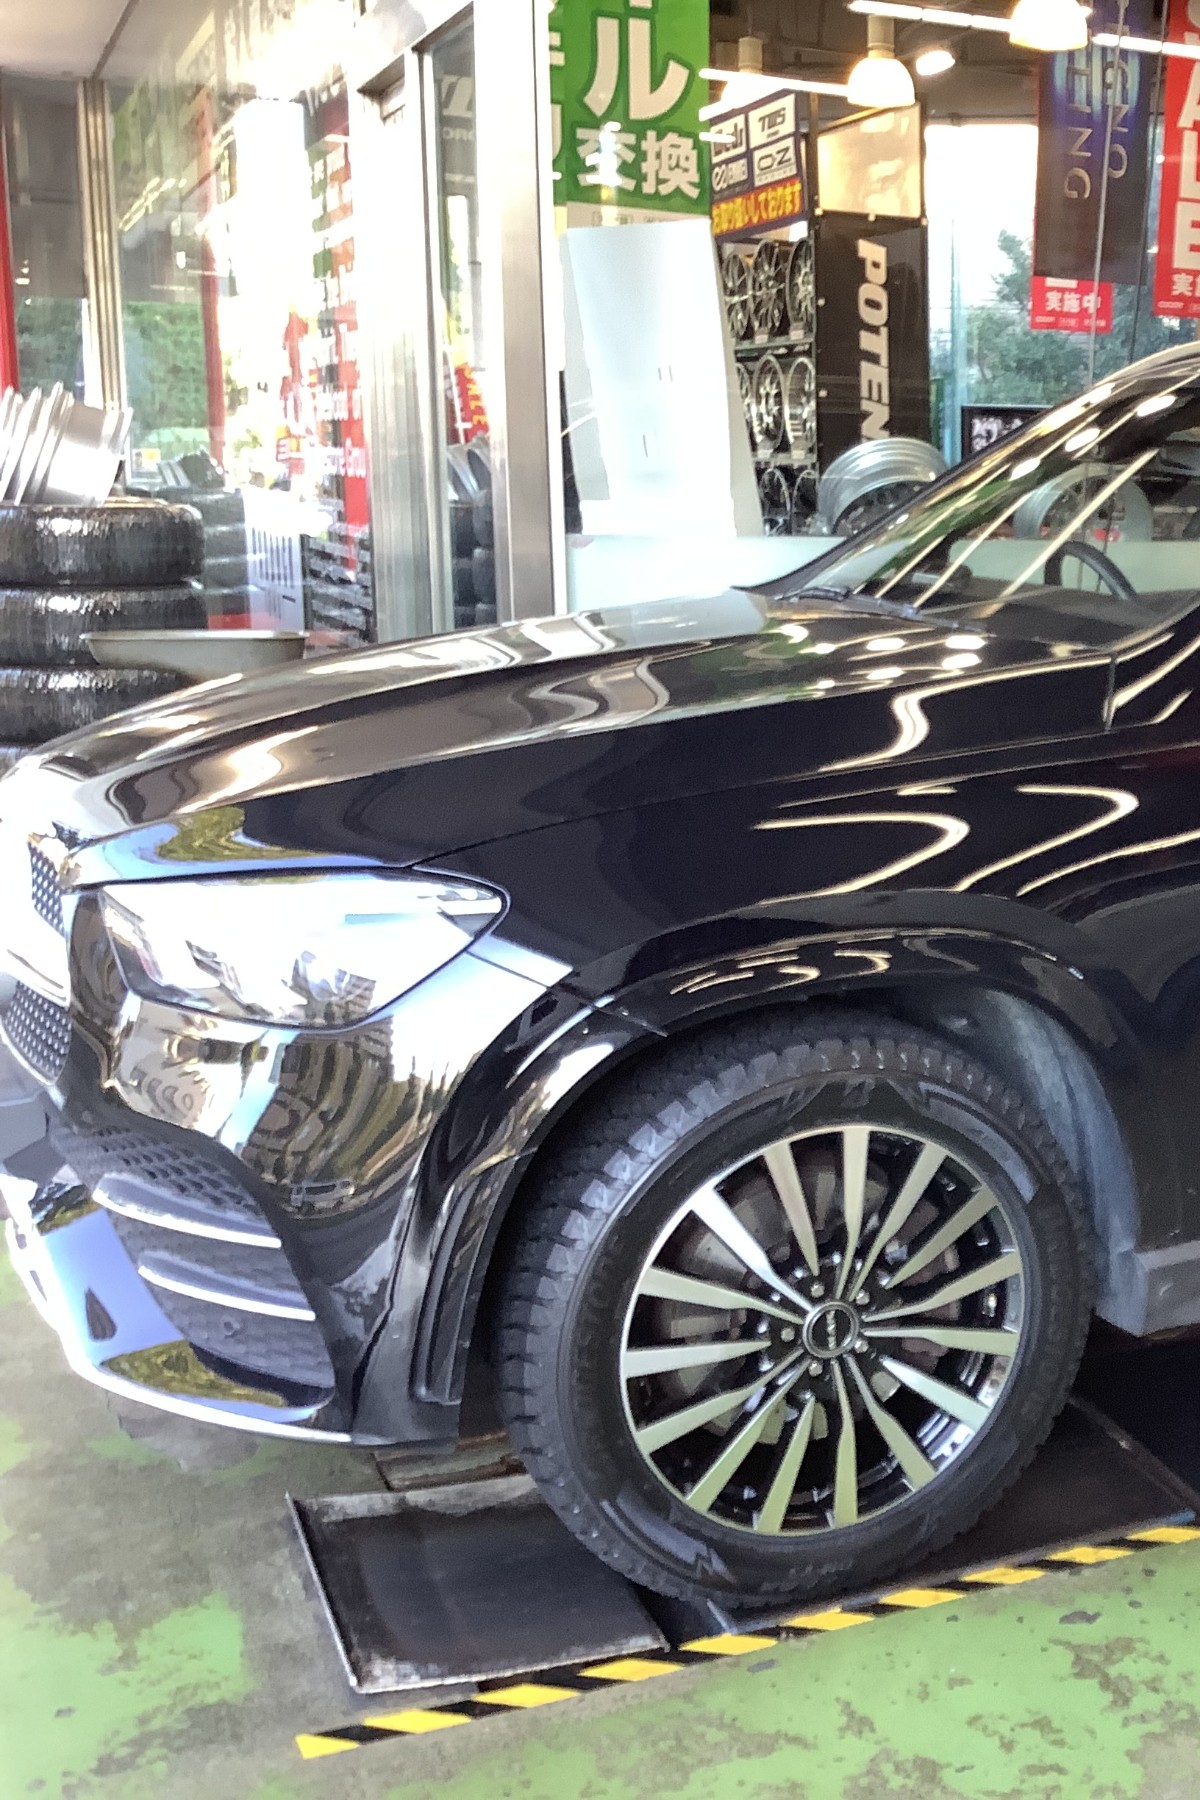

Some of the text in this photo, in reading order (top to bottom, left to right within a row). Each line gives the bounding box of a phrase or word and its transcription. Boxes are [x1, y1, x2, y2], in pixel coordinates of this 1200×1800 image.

[576, 122, 701, 199] 交換
[857, 238, 890, 442] POTEN
[1045, 291, 1102, 313] 実施中
